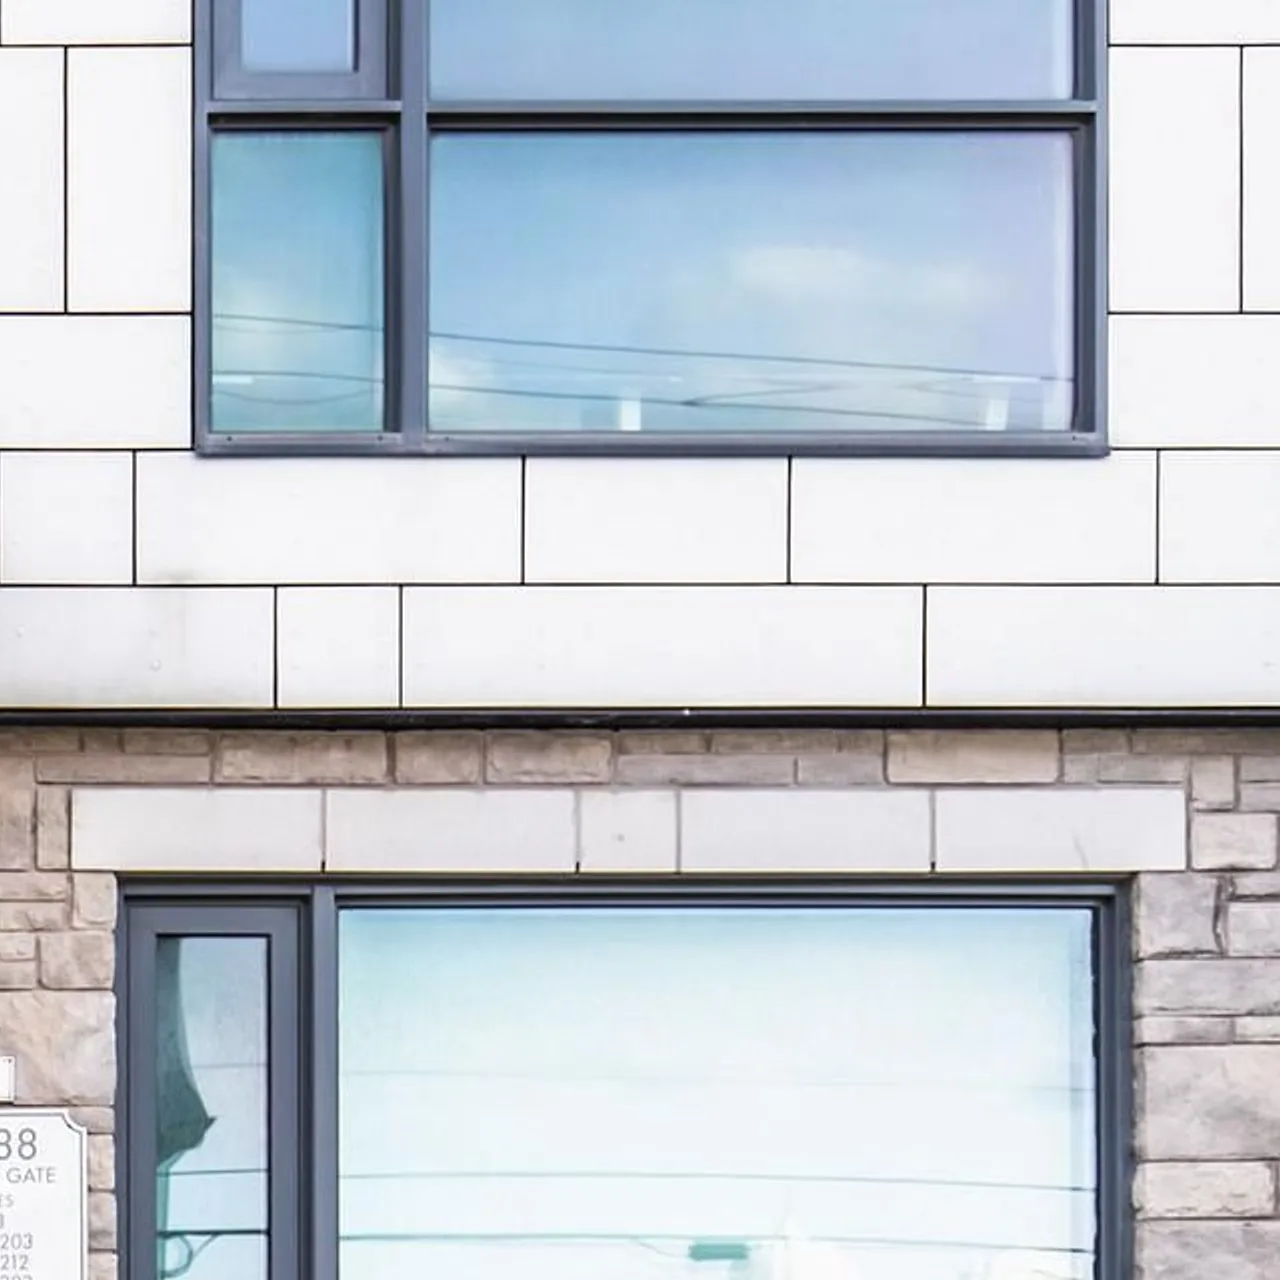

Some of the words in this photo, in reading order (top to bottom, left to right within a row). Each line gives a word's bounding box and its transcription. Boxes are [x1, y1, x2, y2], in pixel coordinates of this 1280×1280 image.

[5, 1167, 57, 1184] GATE
[0, 1232, 33, 1250] 203
[0, 1254, 29, 1271] 212
